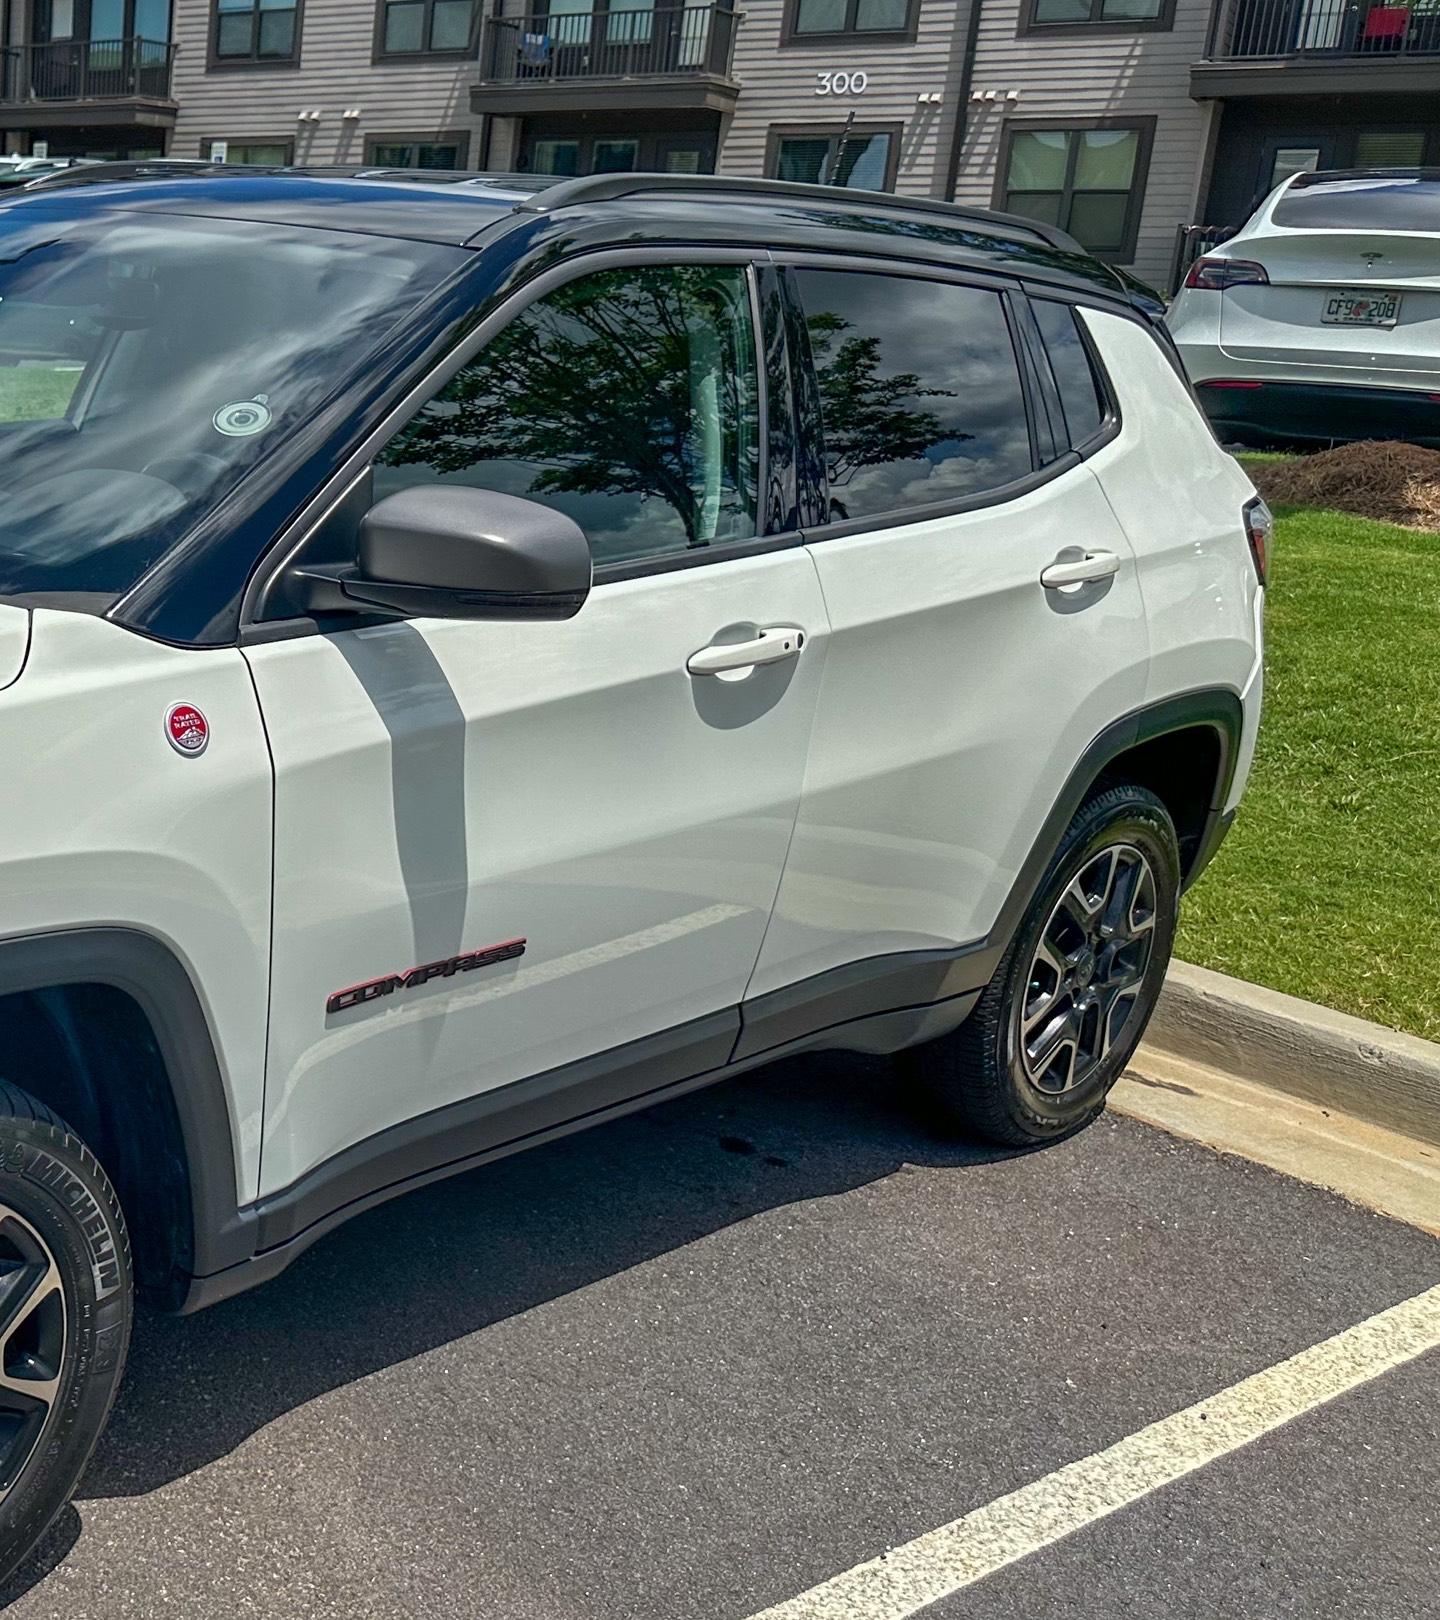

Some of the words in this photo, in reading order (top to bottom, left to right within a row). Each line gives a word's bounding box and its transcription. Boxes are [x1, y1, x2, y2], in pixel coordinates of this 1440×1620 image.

[816, 71, 867, 94] 300
[1327, 299, 1353, 316] CF9
[1369, 301, 1396, 318] 208
[326, 937, 527, 1013] COMPASS
[26, 1148, 121, 1300] MICHELIN
